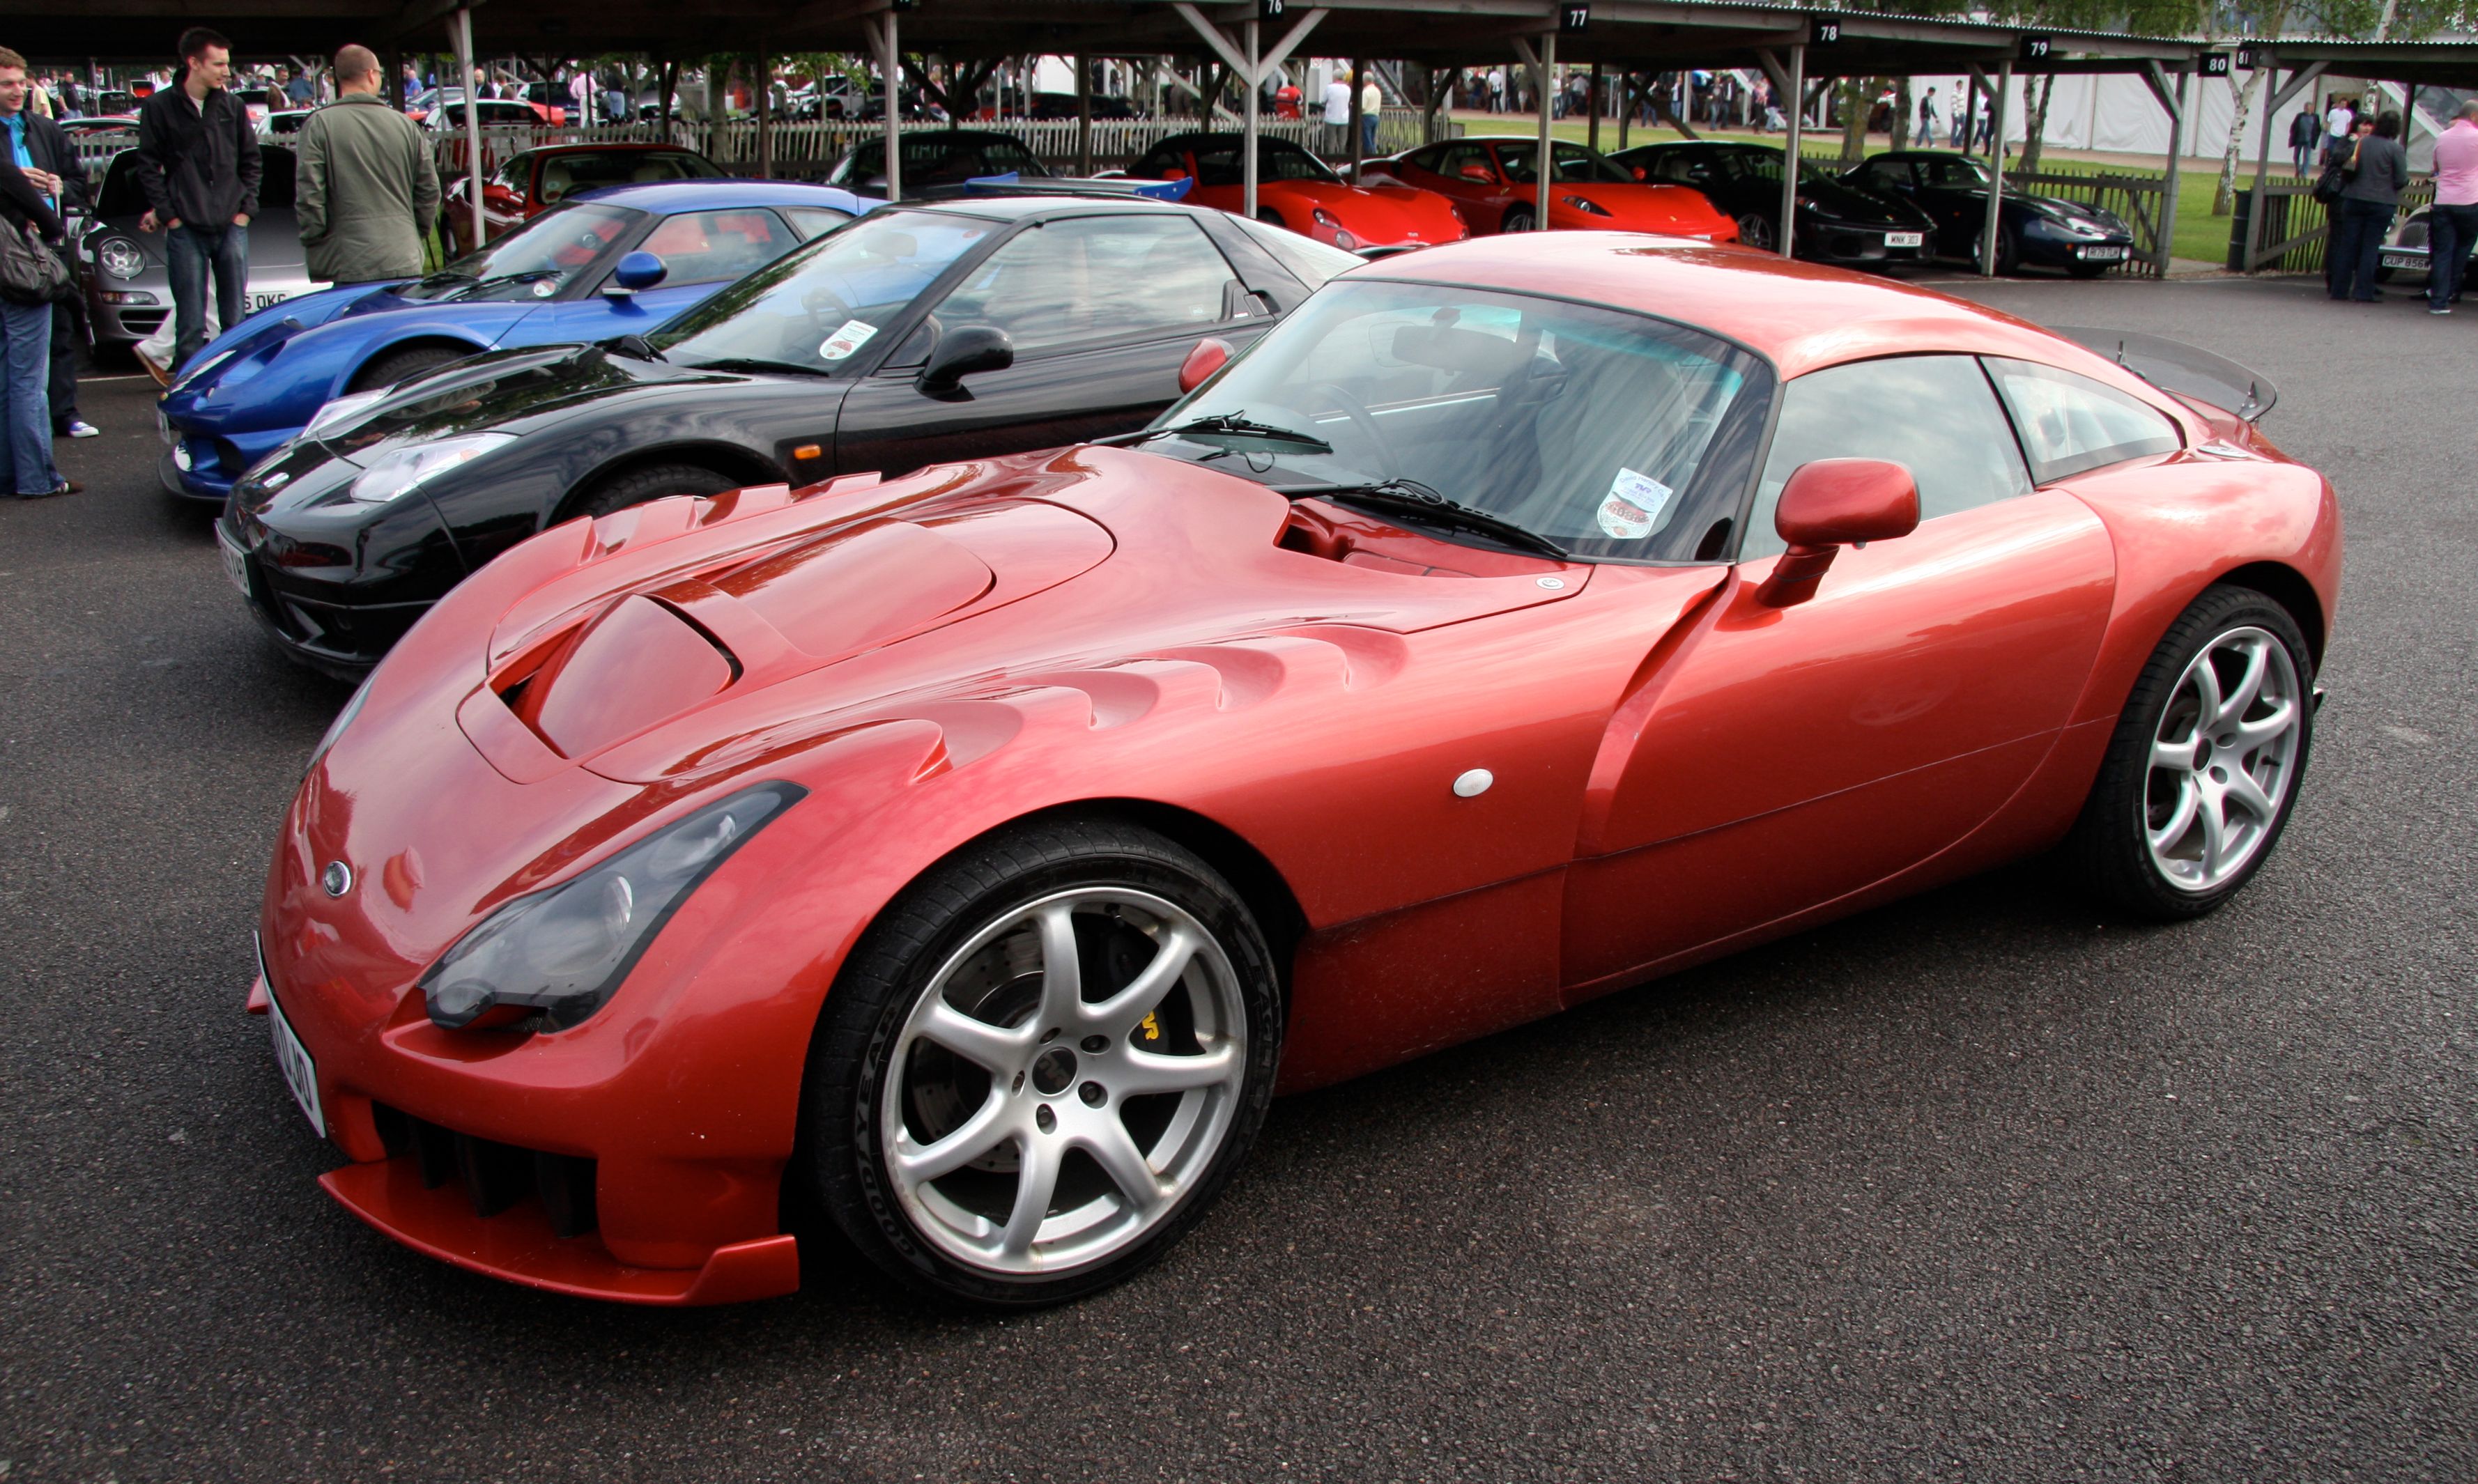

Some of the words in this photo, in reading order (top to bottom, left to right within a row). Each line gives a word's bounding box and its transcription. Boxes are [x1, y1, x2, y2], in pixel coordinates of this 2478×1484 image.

[1268, 0, 1282, 13] 76
[1571, 10, 1587, 26] 77
[1821, 26, 1837, 41] 78
[2031, 42, 2047, 56] 79
[2209, 58, 2226, 72] 80
[2238, 52, 2249, 65] 81
[2384, 256, 2404, 265] CUP
[1635, 483, 1652, 494] TVR
[1141, 1010, 1160, 1040] VR
[855, 1005, 917, 1255] GOODYEAR
